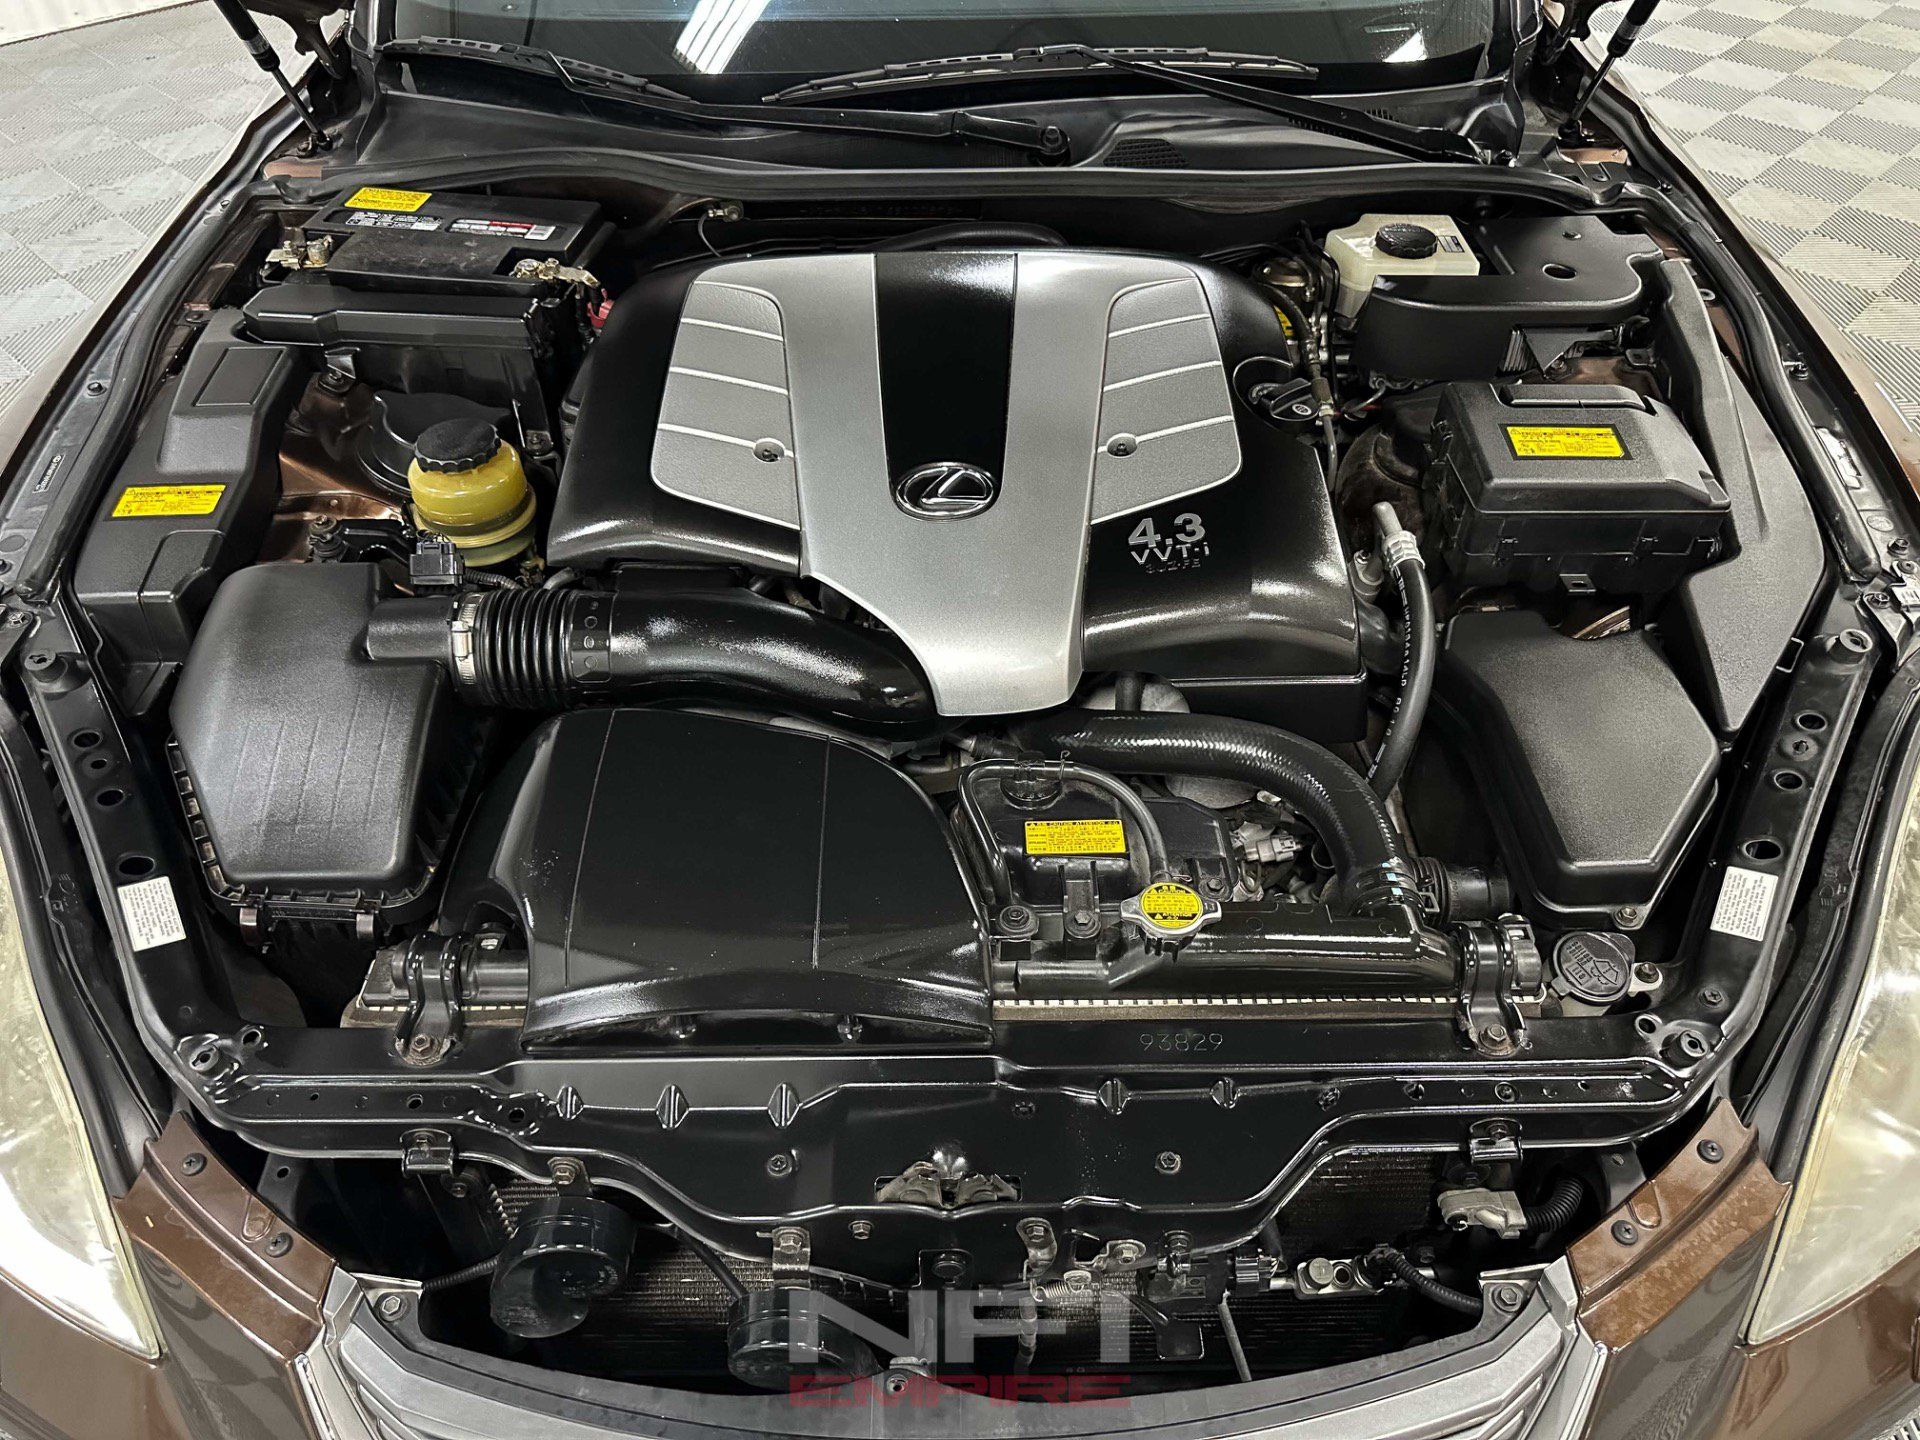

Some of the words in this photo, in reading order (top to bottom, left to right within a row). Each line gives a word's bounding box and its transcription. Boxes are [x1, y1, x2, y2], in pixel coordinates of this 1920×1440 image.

[1128, 512, 1206, 548] 4.3
[1130, 541, 1210, 565] VVT-i
[1139, 1033, 1223, 1052] 93829
